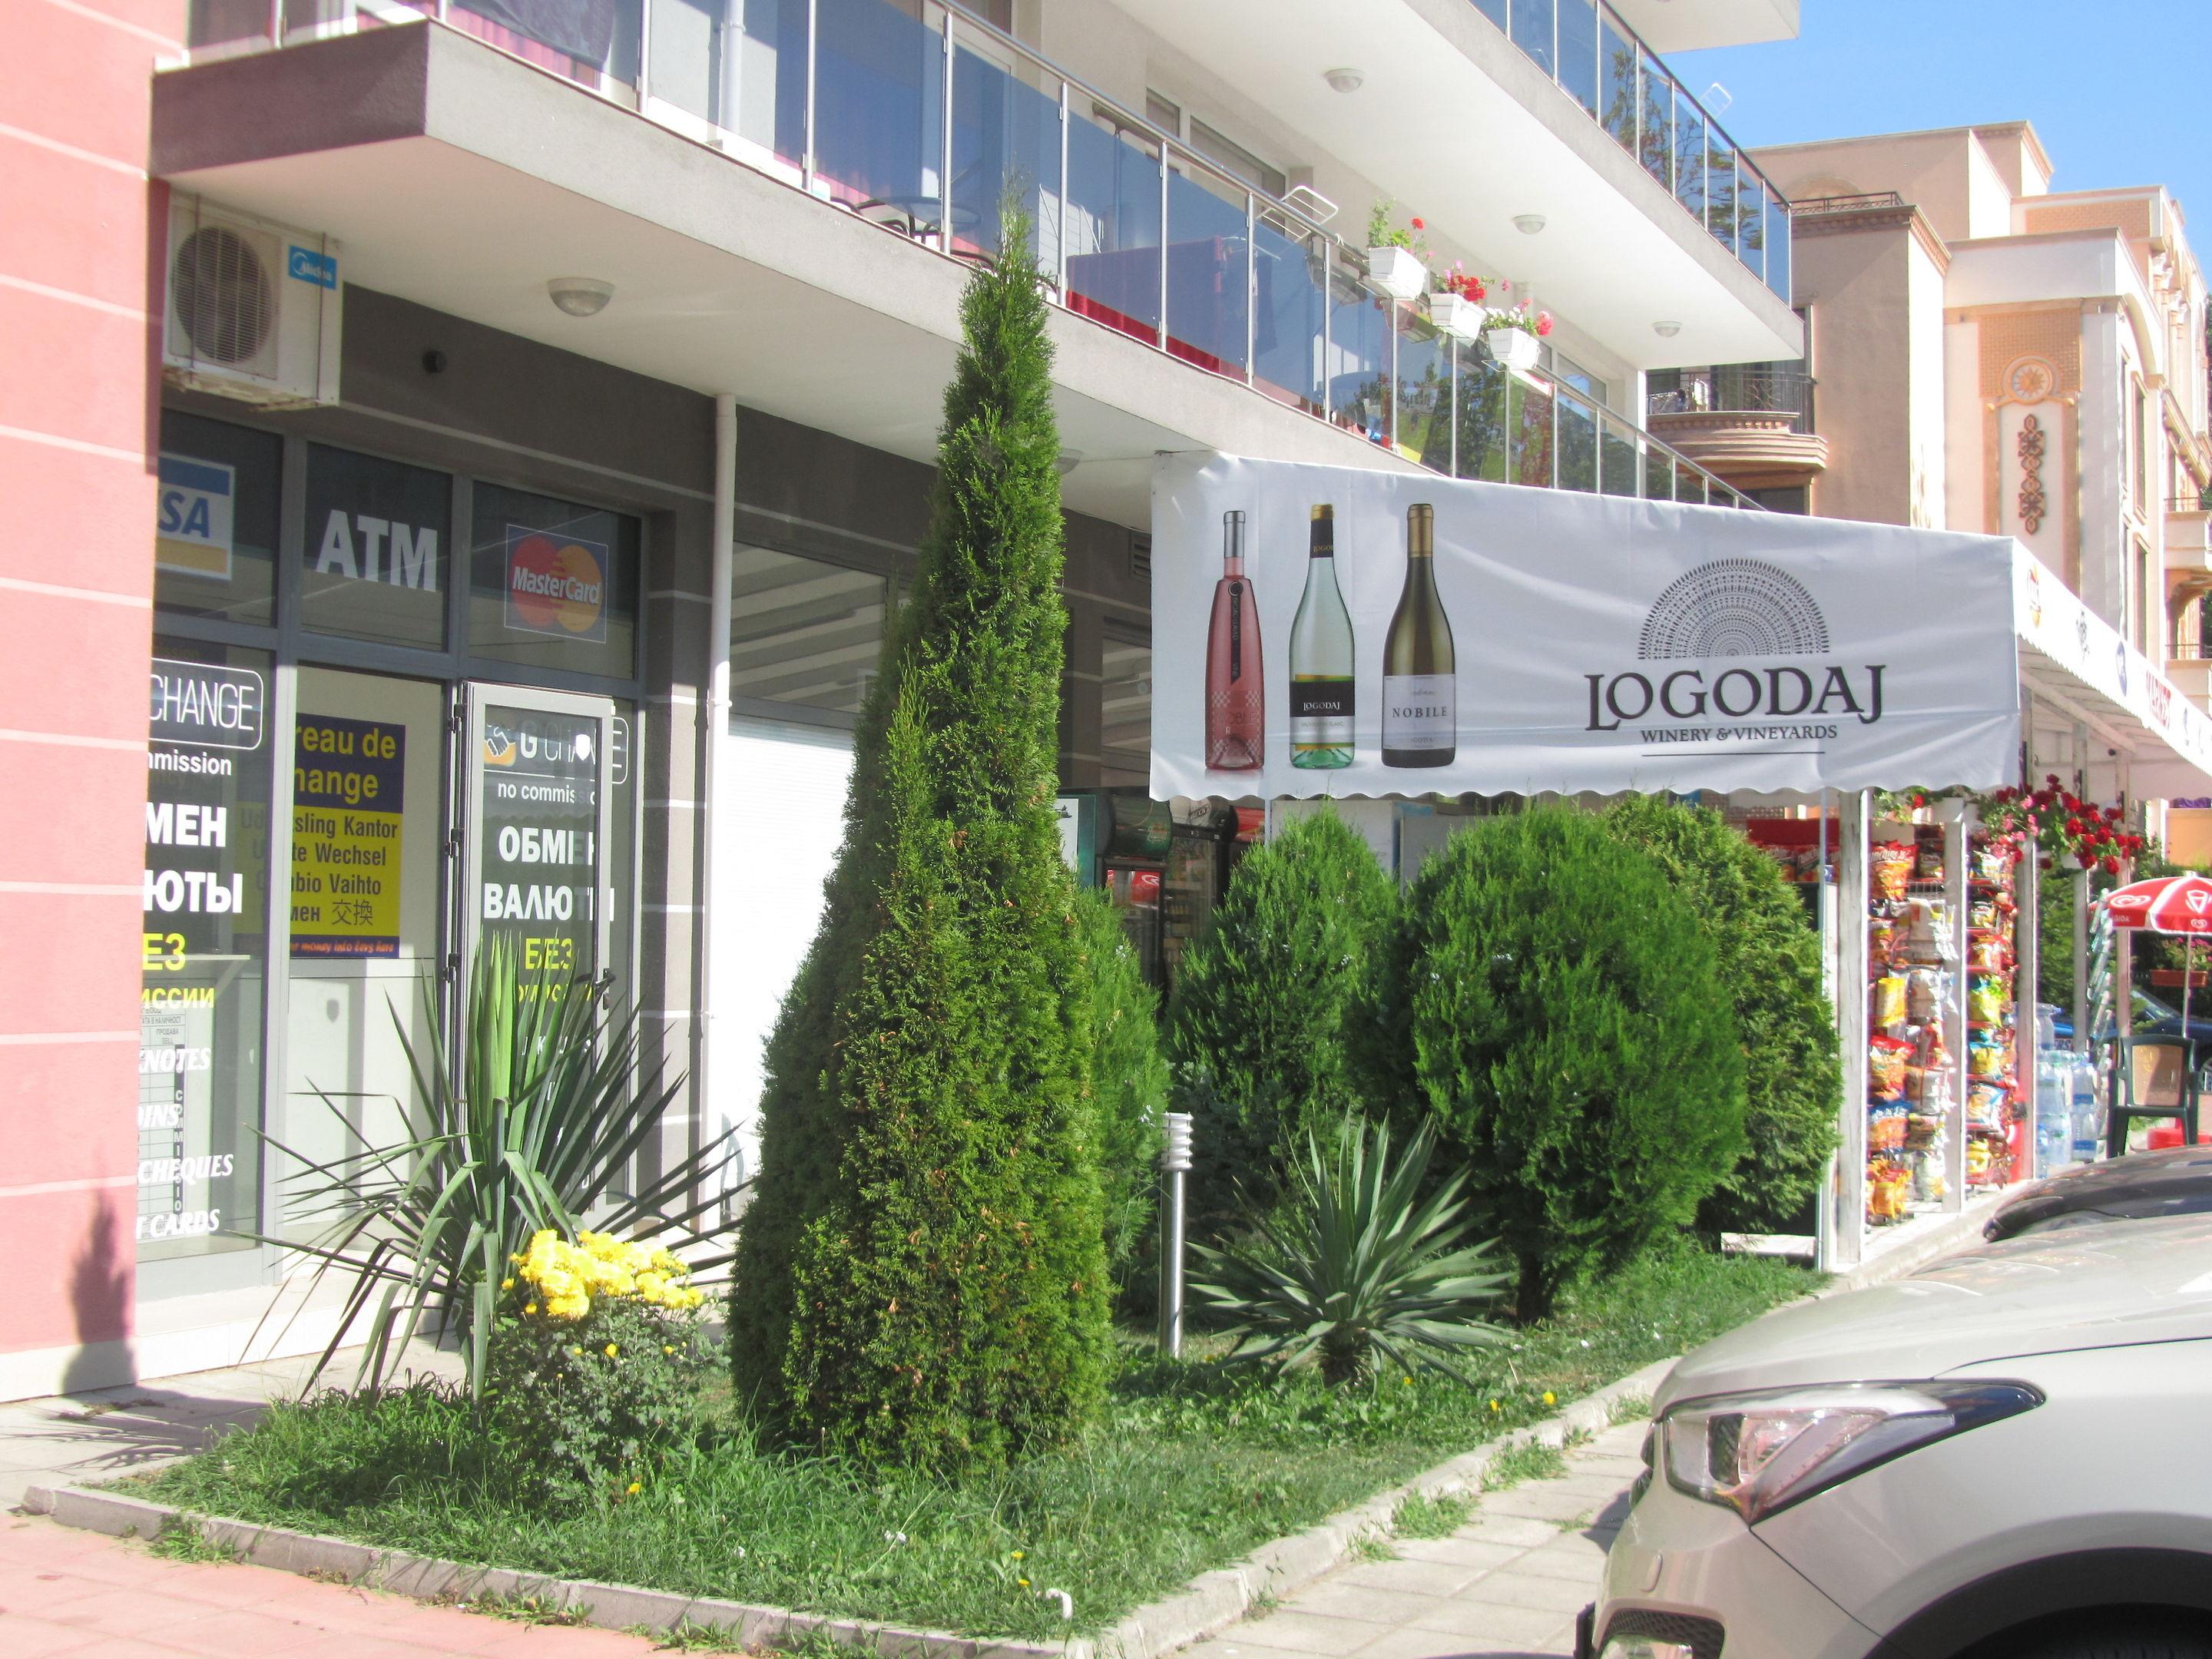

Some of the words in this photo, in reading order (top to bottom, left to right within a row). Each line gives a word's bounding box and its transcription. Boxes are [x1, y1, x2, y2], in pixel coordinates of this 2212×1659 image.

[315, 508, 438, 592] ATM
[512, 565, 601, 604] MasterCard
[1303, 701, 1340, 711] LOGODAJ
[1584, 664, 1886, 731] LOGODAJ
[1392, 706, 1448, 718] NOBILE
[362, 727, 396, 759] de
[1641, 727, 1713, 743] WINERY
[1734, 725, 1838, 740] VINEYARDS
[498, 783, 517, 799] no
[343, 815, 397, 839] Kantor
[315, 842, 386, 866] Wechsel
[291, 872, 322, 892] bio
[329, 873, 382, 896] Vaihto
[150, 1208, 220, 1237] CARDS
